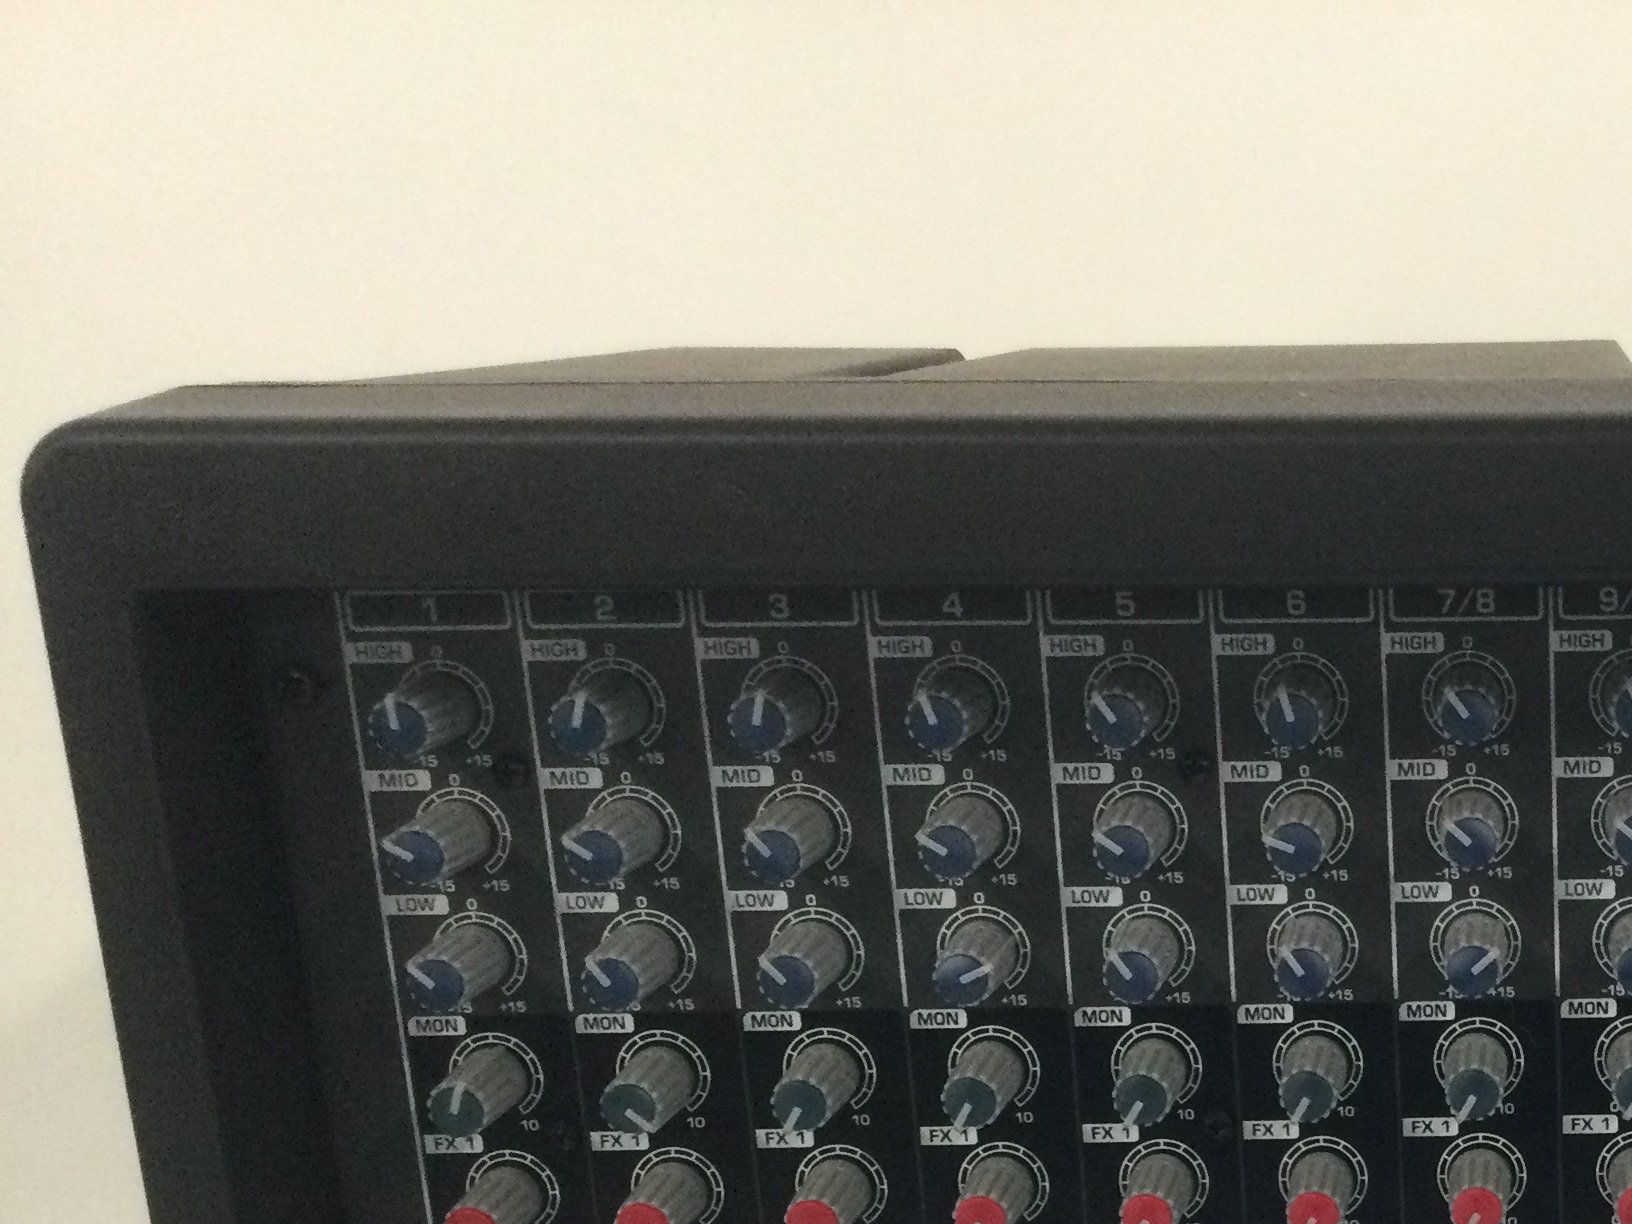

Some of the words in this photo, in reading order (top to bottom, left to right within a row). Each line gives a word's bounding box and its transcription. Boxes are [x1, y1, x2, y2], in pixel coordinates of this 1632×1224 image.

[769, 595, 790, 618] 3
[942, 592, 963, 617] 4
[1438, 590, 1496, 614] 7/8
[1558, 633, 1605, 649] HIGH
[1397, 762, 1435, 776] MID
[1563, 760, 1600, 775] MID
[377, 772, 418, 787] MID
[1564, 881, 1605, 896] LOW
[1567, 1001, 1609, 1016] MON
[1082, 1010, 1123, 1024] MON
[415, 1019, 458, 1034] MON
[1091, 1126, 1114, 1139] FX
